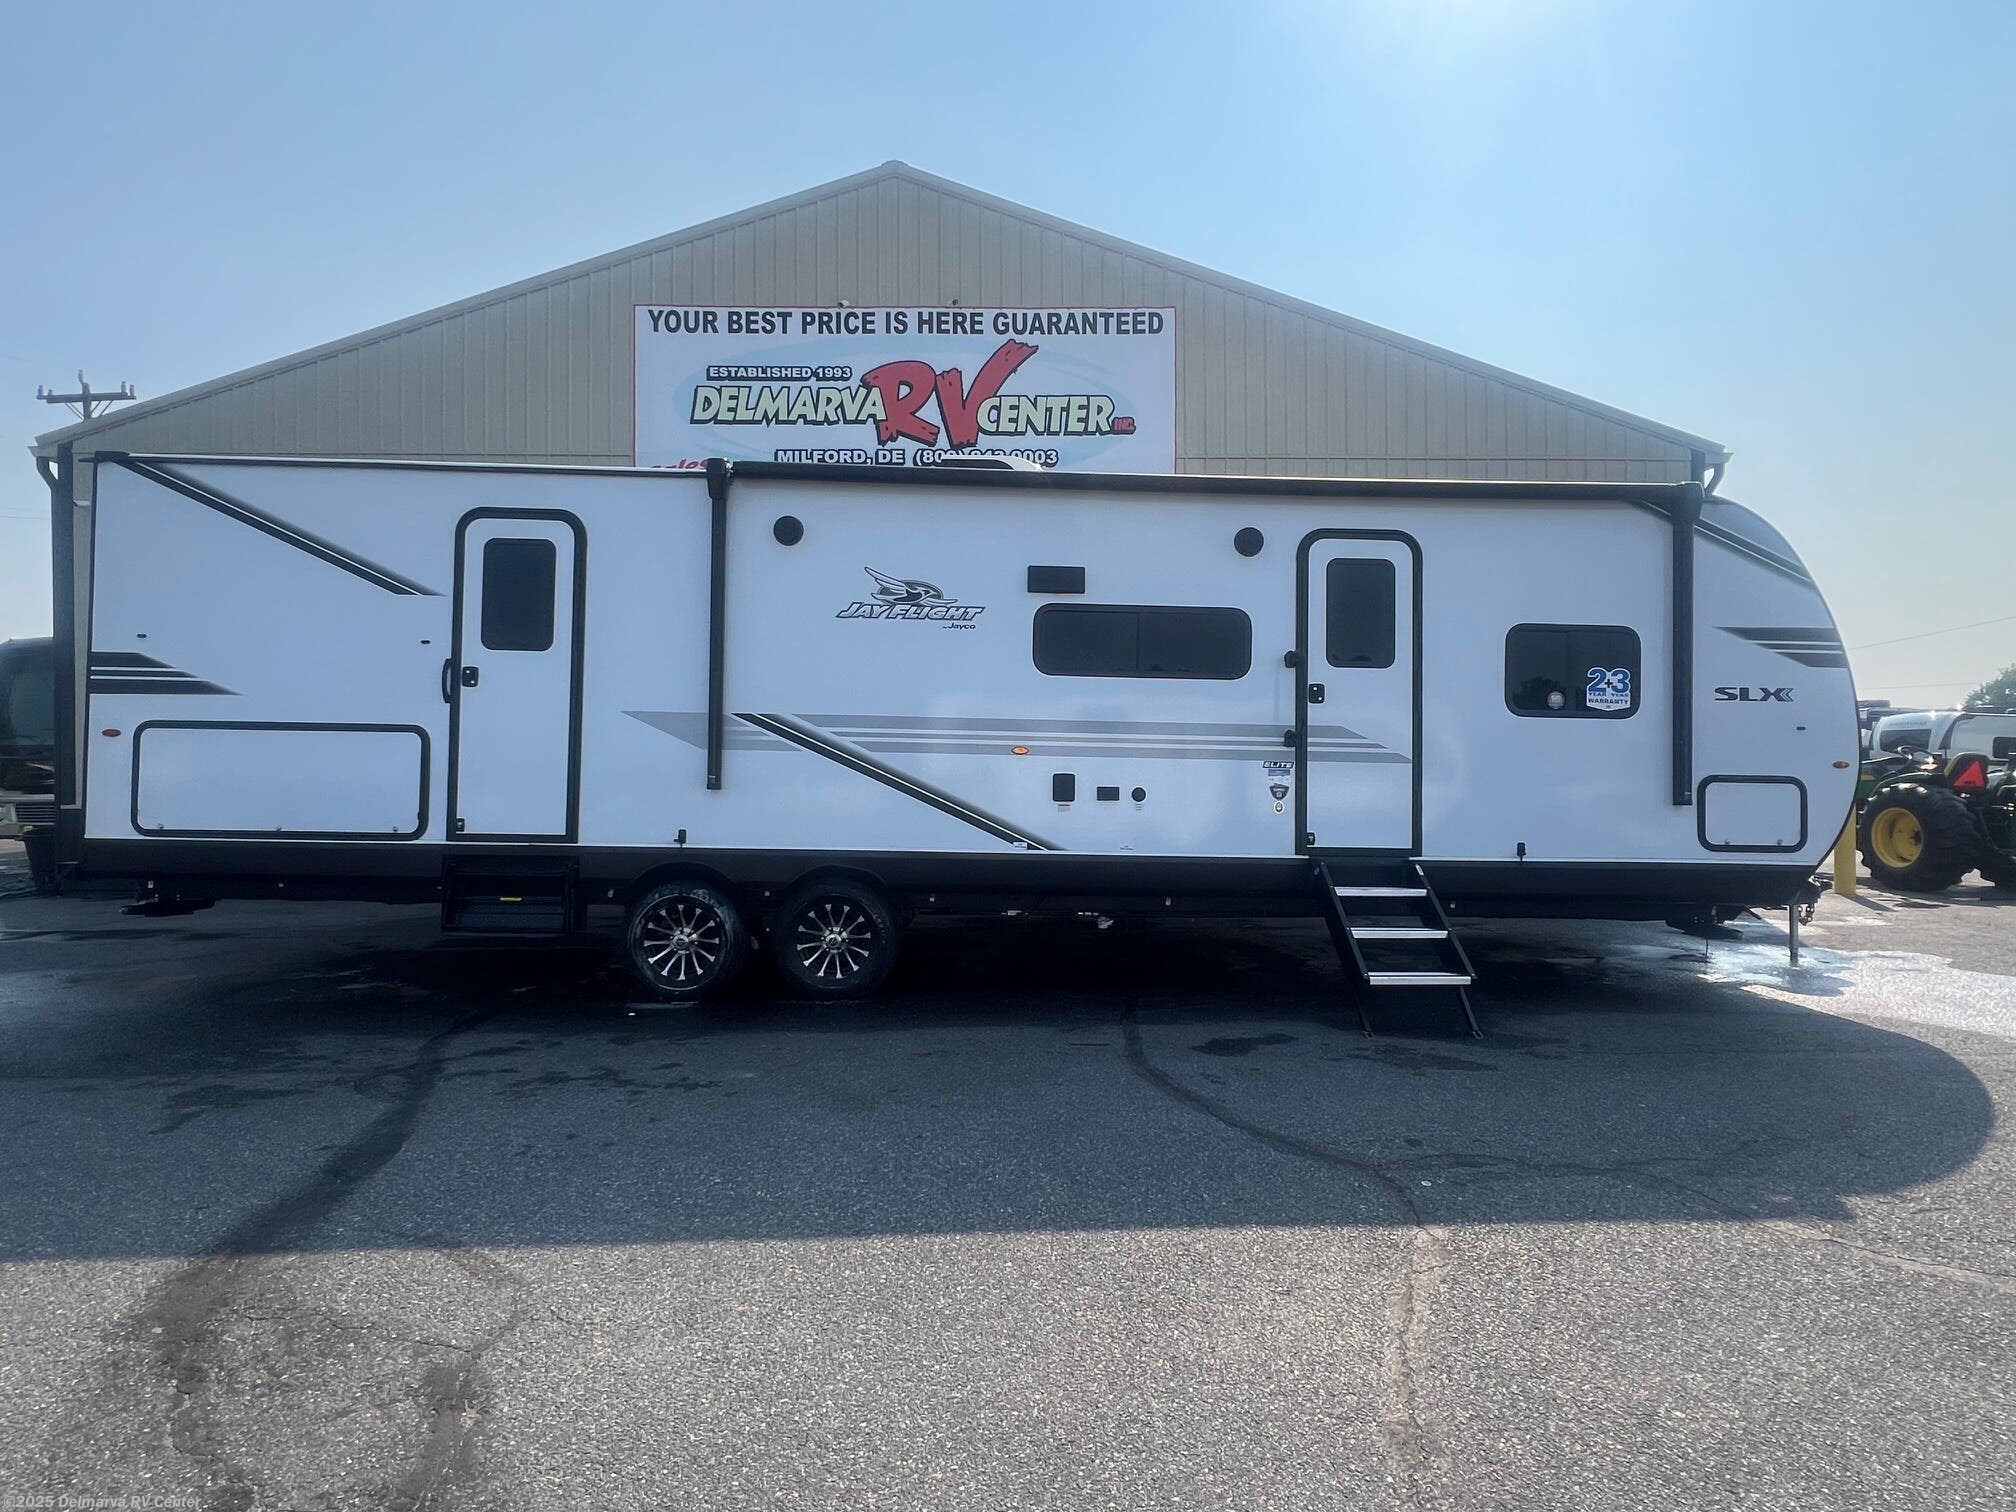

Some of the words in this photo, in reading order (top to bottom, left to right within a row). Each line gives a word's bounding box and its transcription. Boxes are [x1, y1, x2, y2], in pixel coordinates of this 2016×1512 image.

[648, 310, 719, 334] YOUR
[727, 311, 793, 335] BEST
[801, 312, 876, 335] PRICE
[885, 312, 909, 335] IS
[917, 312, 984, 335] HERE
[993, 312, 1164, 335] GUARANTEED
[708, 366, 812, 380] ESTABLISHED
[815, 367, 852, 380] 1993
[691, 385, 887, 425] DELMARVA
[860, 339, 1039, 448] RV
[976, 395, 1115, 435] CENTER
[776, 450, 873, 466] MILFORD,
[877, 450, 905, 466] DE
[836, 602, 890, 619] JAY
[885, 604, 986, 621] FLIGHT
[948, 623, 976, 631] Jayco
[1714, 686, 1794, 702] SLX
